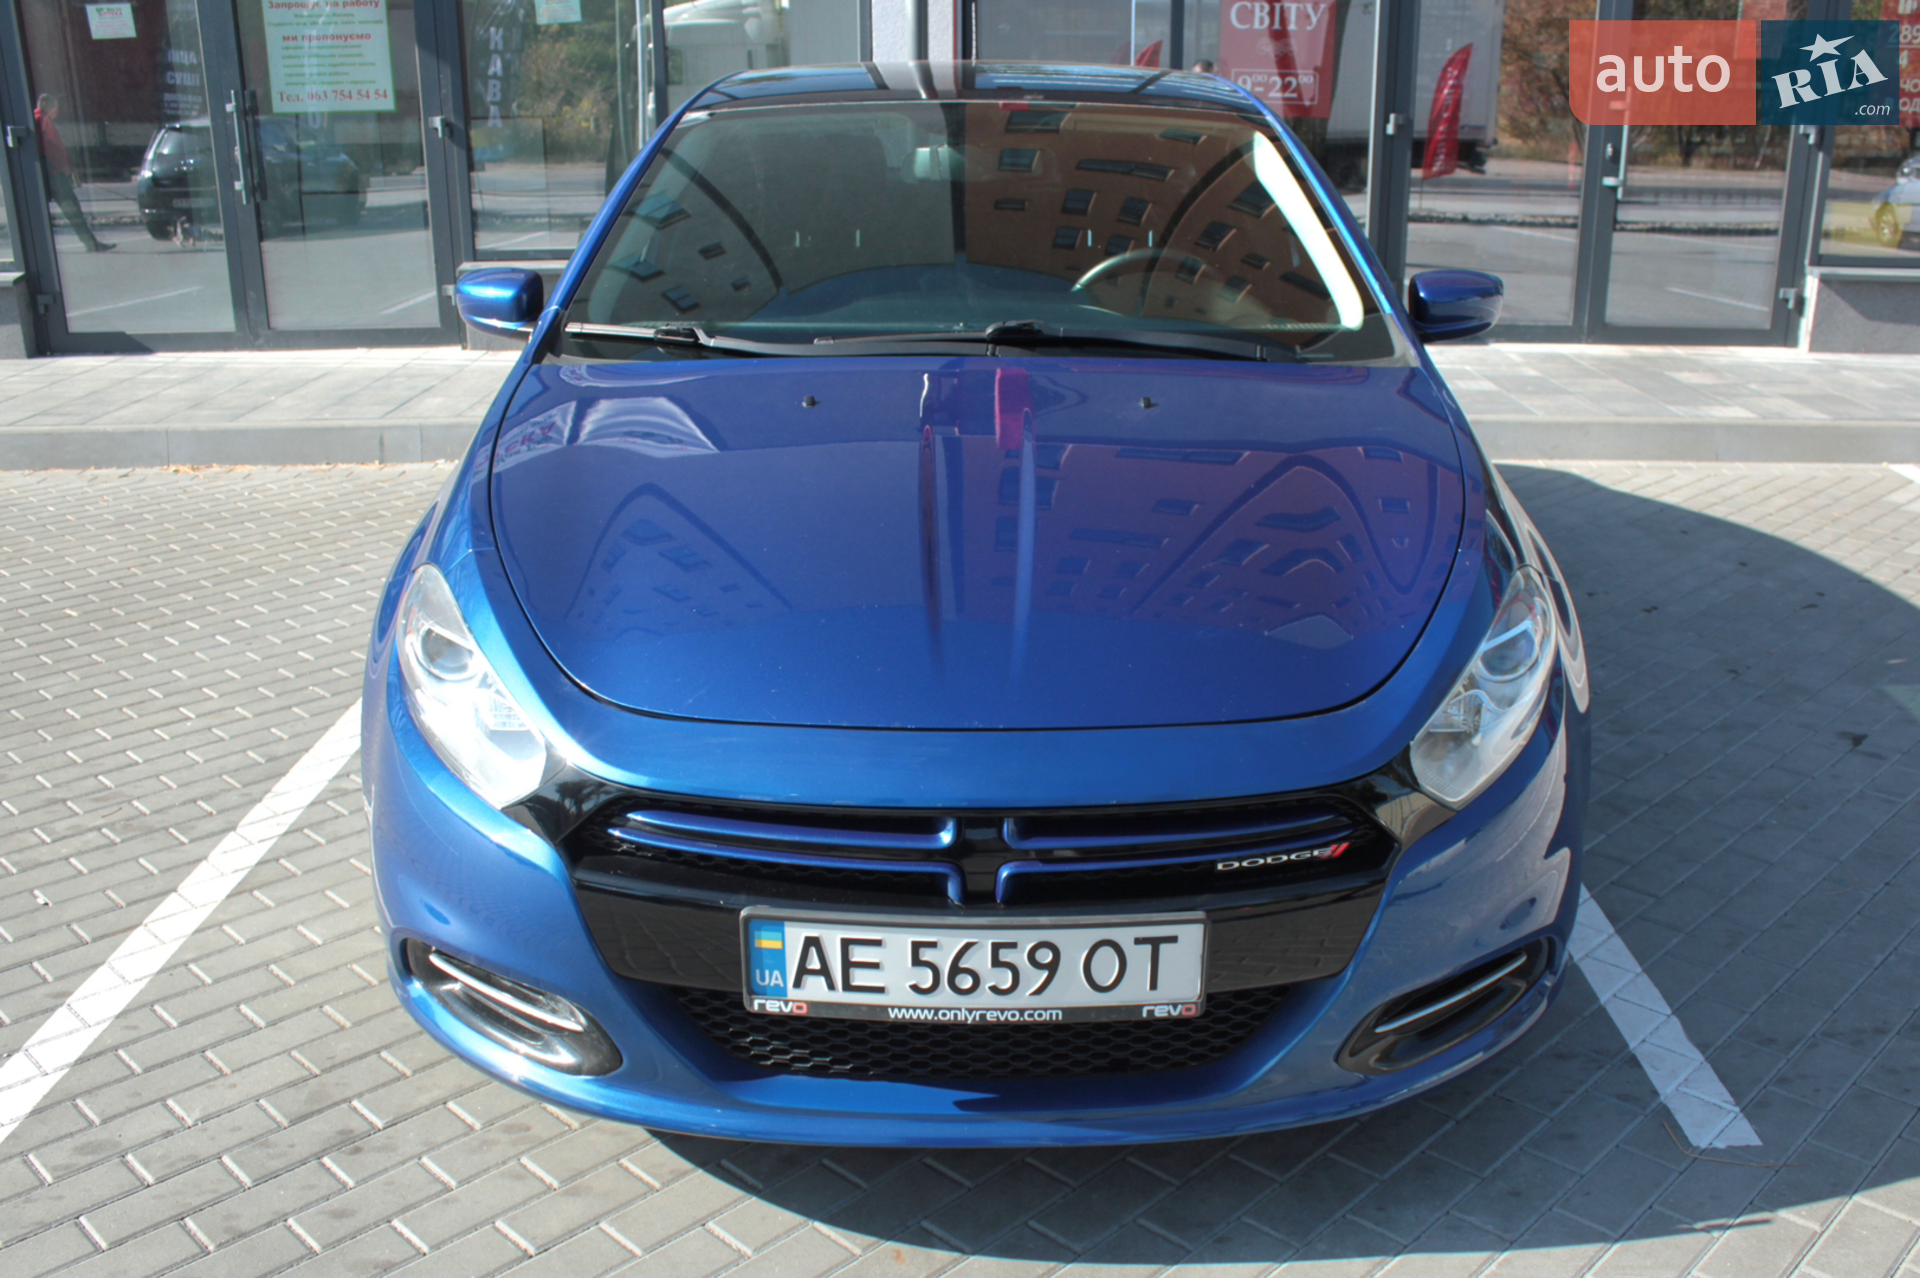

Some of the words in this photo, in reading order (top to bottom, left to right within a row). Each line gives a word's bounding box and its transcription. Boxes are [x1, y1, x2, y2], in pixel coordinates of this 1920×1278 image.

[1230, 1, 1327, 31] СВІТУ
[282, 33, 298, 42] ми
[301, 32, 372, 42] пропонуємо
[487, 26, 504, 128] КАВА
[277, 90, 304, 102] Тел.
[307, 91, 329, 100] 063
[332, 90, 353, 100] 754
[357, 89, 370, 100] 54
[374, 88, 388, 100] 54
[1216, 847, 1333, 871] DODGE
[792, 935, 886, 994] AE
[907, 939, 1061, 997] 5659
[1082, 934, 1179, 994] OT
[755, 969, 784, 988] UA
[753, 999, 808, 1014] revo
[888, 1007, 1063, 1024] www.onlyrevo.com
[1142, 1003, 1198, 1018] revo
